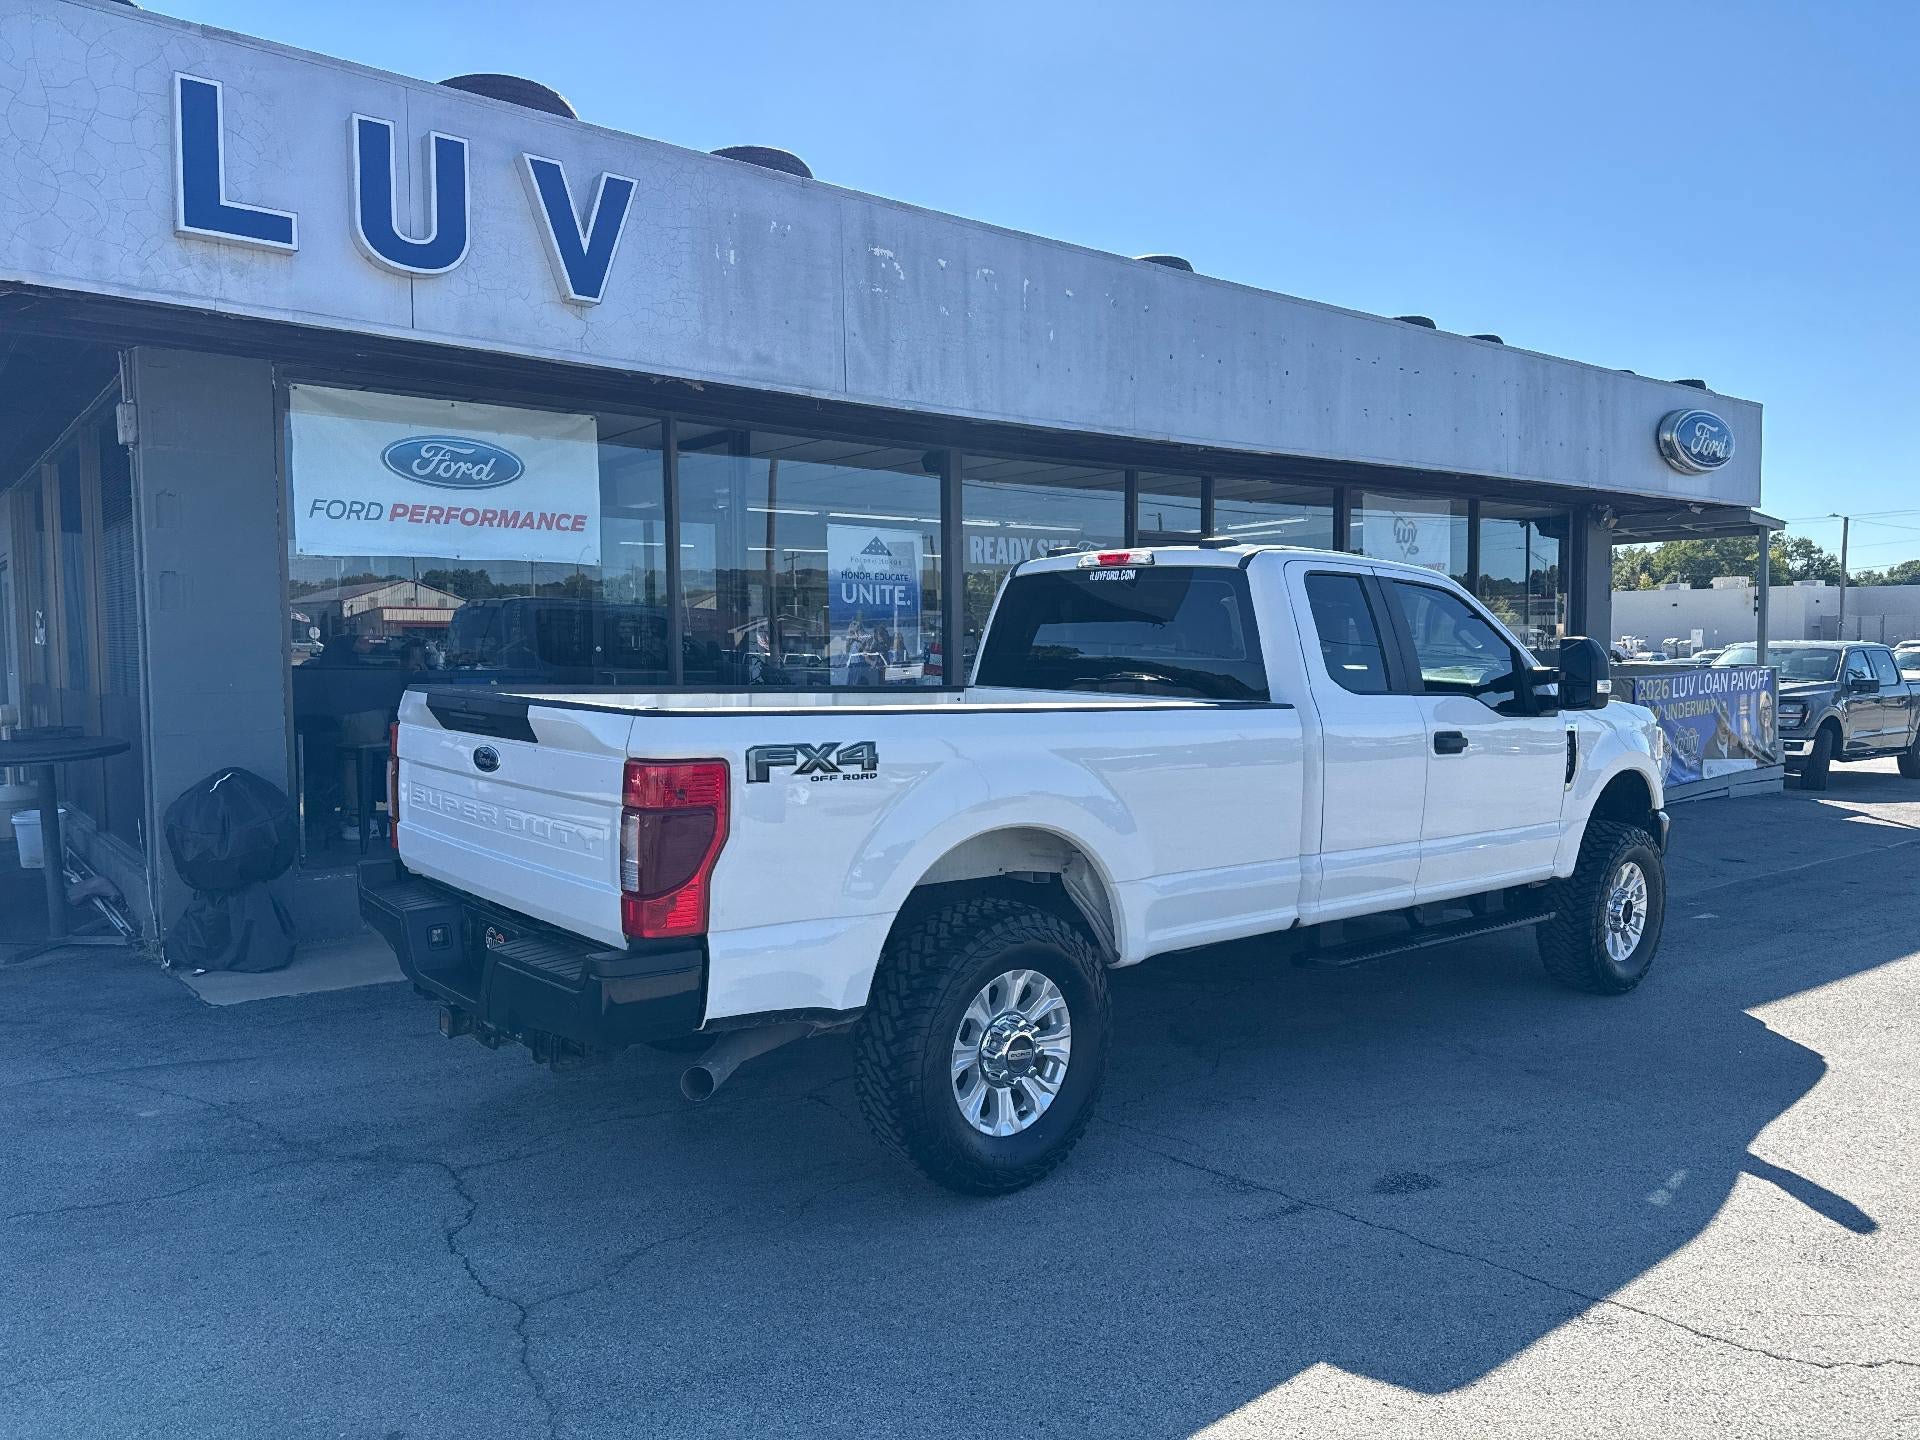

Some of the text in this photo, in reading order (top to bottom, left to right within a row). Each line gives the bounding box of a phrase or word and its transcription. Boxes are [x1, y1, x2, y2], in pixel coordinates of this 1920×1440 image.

[171, 71, 640, 308] LUV
[1690, 422, 1727, 458] Ford
[411, 443, 496, 482] Ford
[308, 498, 588, 532] FORD PERFORMANCE
[969, 536, 1033, 565] READY
[1396, 527, 1418, 543] LUV
[841, 583, 911, 606] UNITE.
[1638, 669, 1770, 701] 2026 LUV LOAN PAYOFF
[1664, 699, 1718, 720] UNDERWAY
[745, 741, 879, 784] FX4
[843, 773, 877, 781] ROAD
[411, 787, 604, 850] SUPER DUTY
